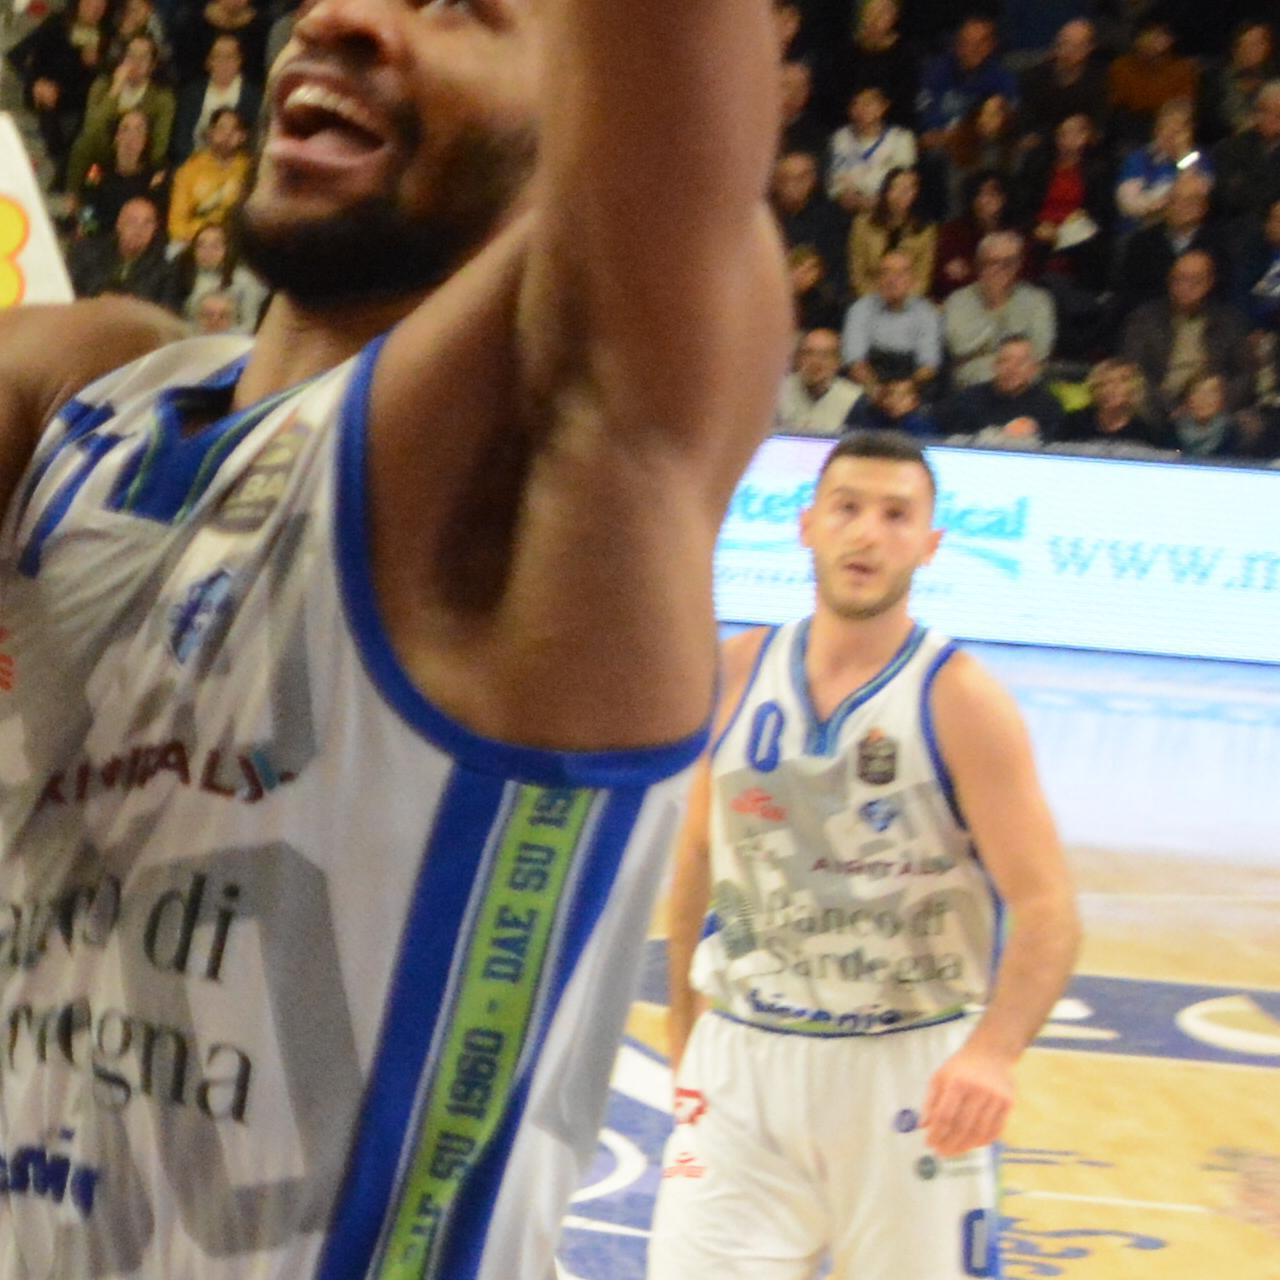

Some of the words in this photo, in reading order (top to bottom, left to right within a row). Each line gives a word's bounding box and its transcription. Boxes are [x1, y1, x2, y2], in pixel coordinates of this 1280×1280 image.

[508, 839, 558, 893] SU
[143, 872, 242, 984] di
[482, 903, 539, 986] DAE
